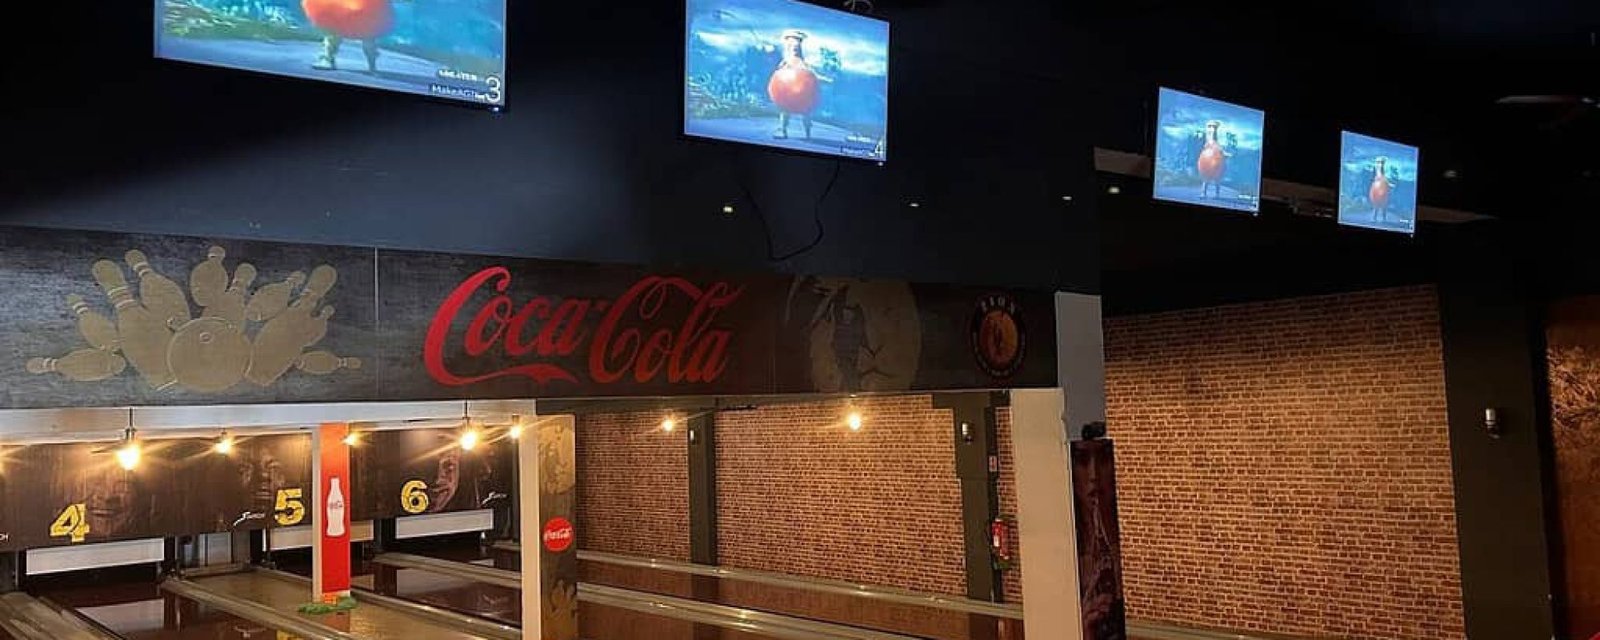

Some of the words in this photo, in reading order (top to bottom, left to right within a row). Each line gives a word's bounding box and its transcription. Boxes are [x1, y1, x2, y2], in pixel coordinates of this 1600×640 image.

[485, 76, 501, 103] 3
[424, 266, 743, 386] Coca-Cola
[274, 488, 305, 525] 5
[401, 480, 429, 513] 6
[50, 503, 90, 542] 4
